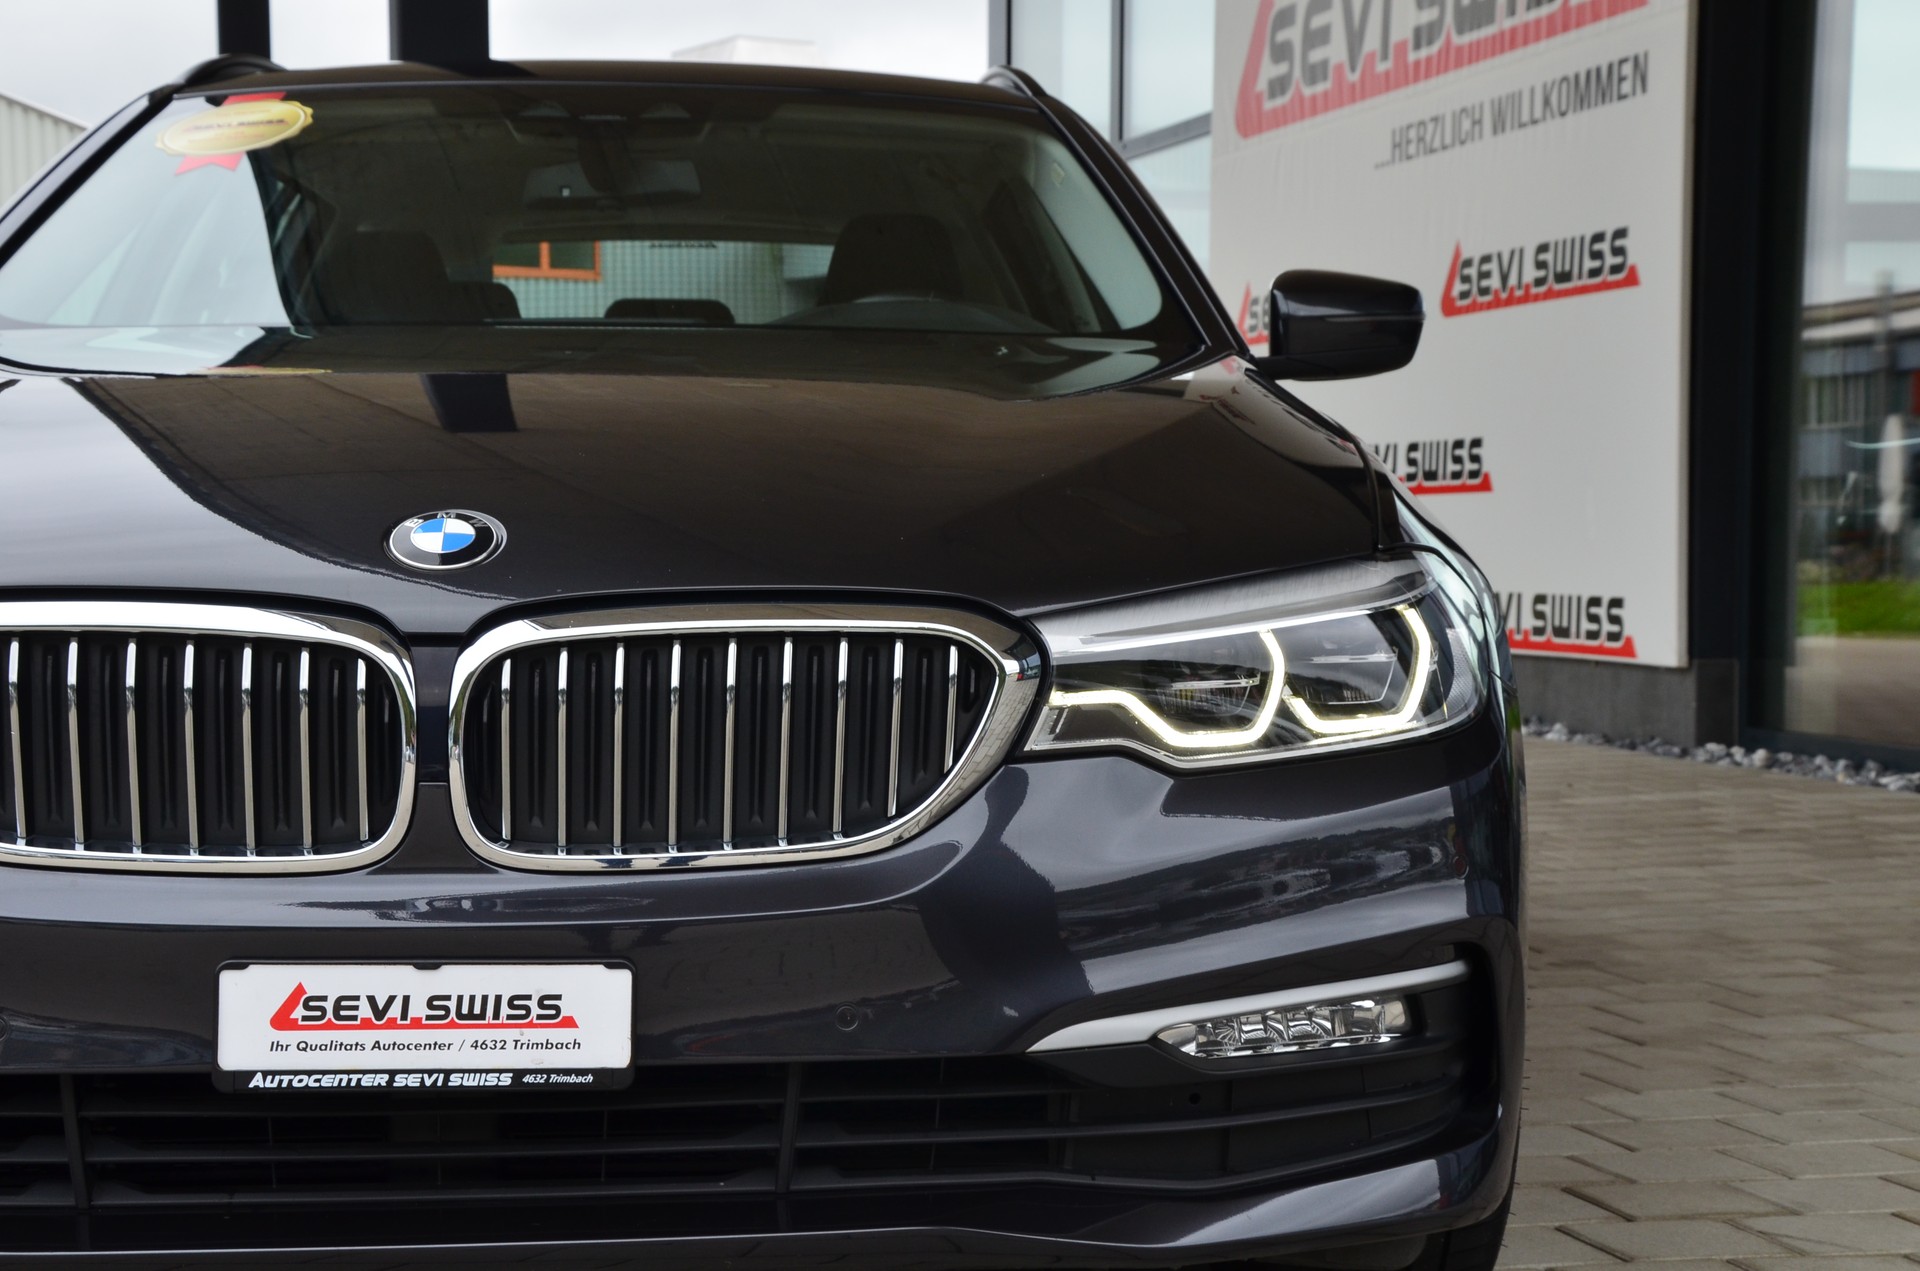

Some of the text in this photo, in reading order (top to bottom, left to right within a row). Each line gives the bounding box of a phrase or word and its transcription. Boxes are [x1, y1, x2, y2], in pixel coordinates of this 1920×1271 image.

[1266, 0, 1390, 101] SEVI
[1490, 50, 1649, 137] WILLKOMMEN
[1458, 226, 1629, 301] SEVI SWISS
[1405, 436, 1483, 482] SWISS
[1532, 594, 1625, 642] SWISS
[300, 993, 563, 1022] SEVI SWISS
[270, 1038, 581, 1053] Ihr Qualitats Autocenter / 4632 Trimbach
[392, 1073, 445, 1087] SEVI
[448, 1073, 513, 1087] SWISS
[522, 1074, 547, 1083] 4632
[549, 1073, 593, 1084] Trimbach
